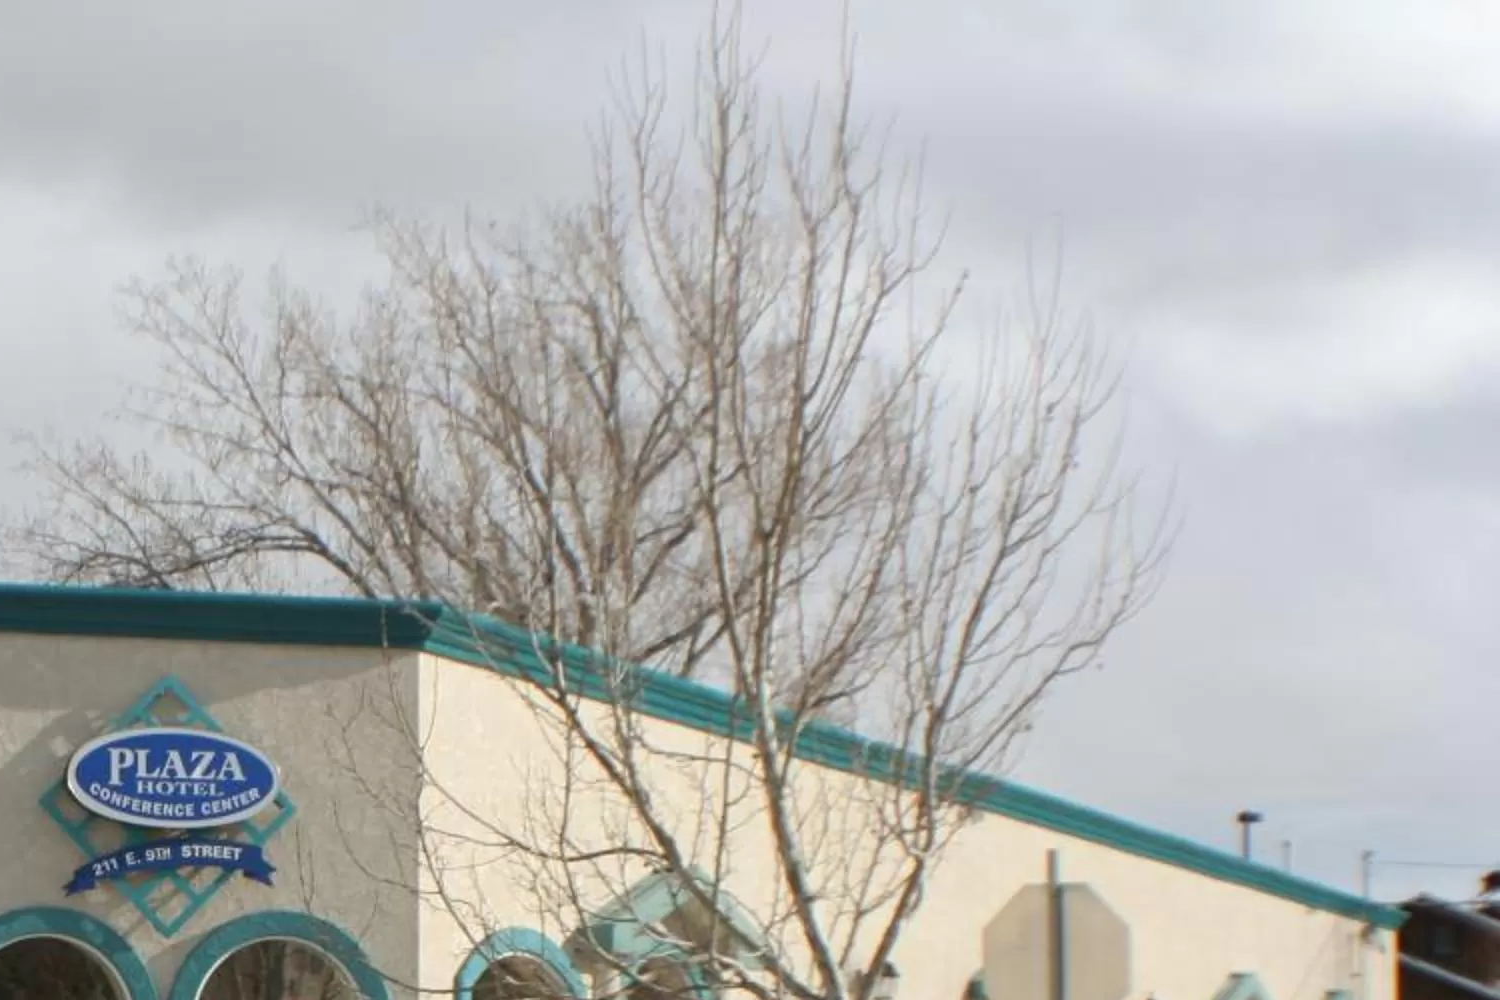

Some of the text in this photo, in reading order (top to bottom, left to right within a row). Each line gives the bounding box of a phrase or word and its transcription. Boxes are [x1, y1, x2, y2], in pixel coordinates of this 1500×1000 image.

[107, 747, 247, 786] PLAZA
[89, 782, 261, 817] CONFERENCE CENTER
[137, 780, 225, 797] HOTEL
[92, 844, 243, 876] 211 E. 9TH STREET
